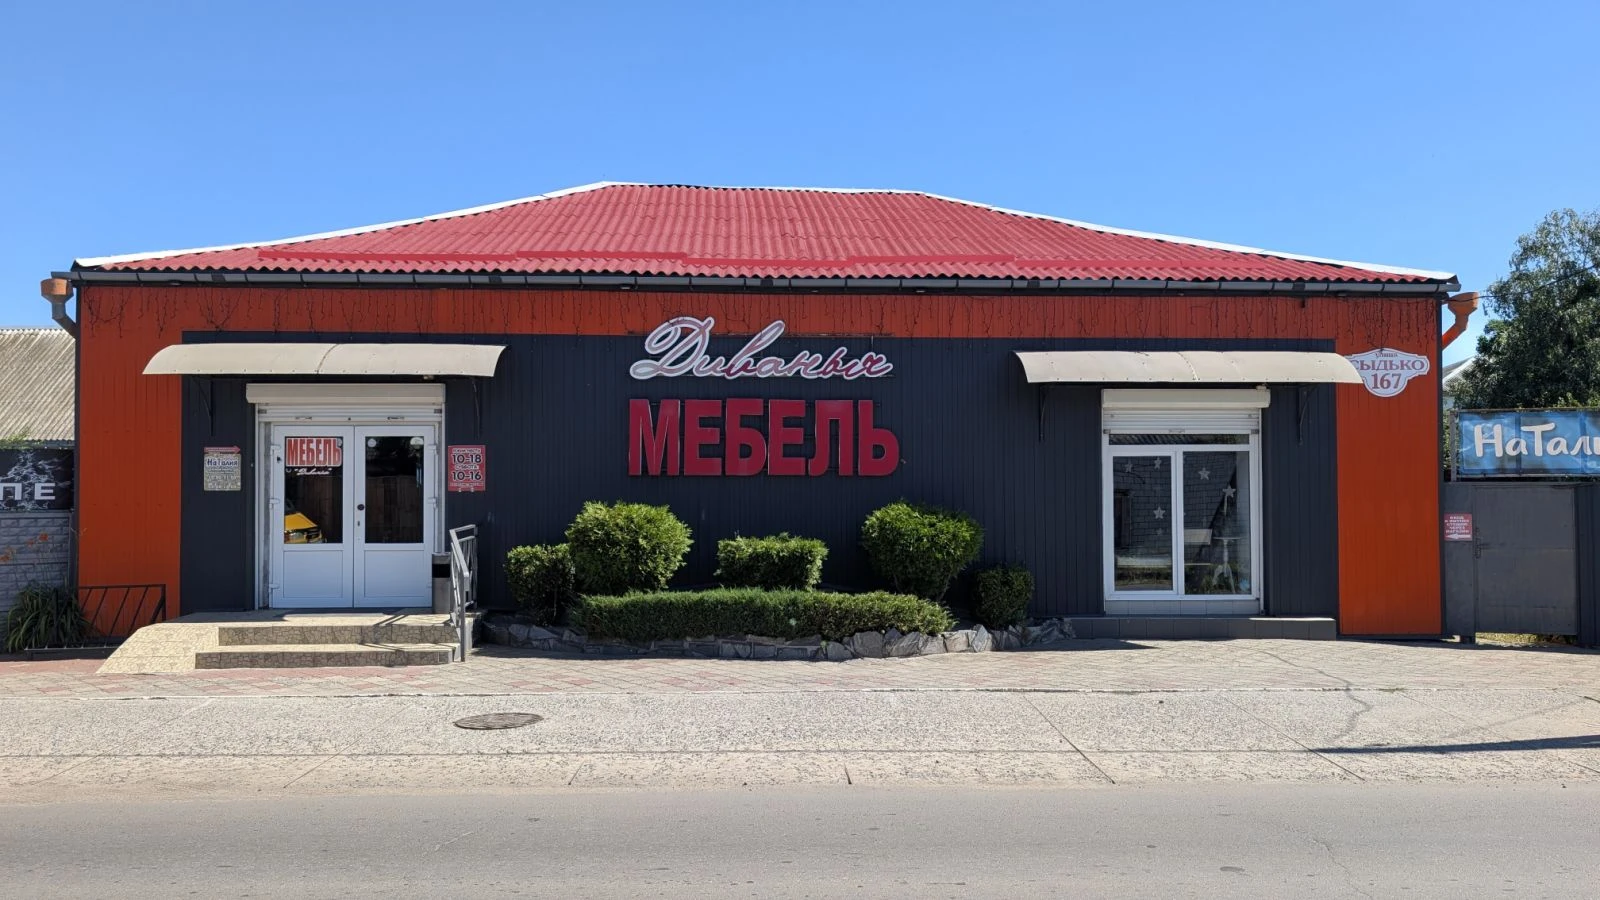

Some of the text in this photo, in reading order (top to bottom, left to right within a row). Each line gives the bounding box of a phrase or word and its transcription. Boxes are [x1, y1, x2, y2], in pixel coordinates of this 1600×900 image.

[1372, 373, 1401, 389] 167
[629, 398, 900, 477] МЕБЕЛЬ
[286, 438, 342, 467] МЕБЕЛЬ
[452, 454, 482, 463] 10-18
[452, 471, 482, 480] 10-16
